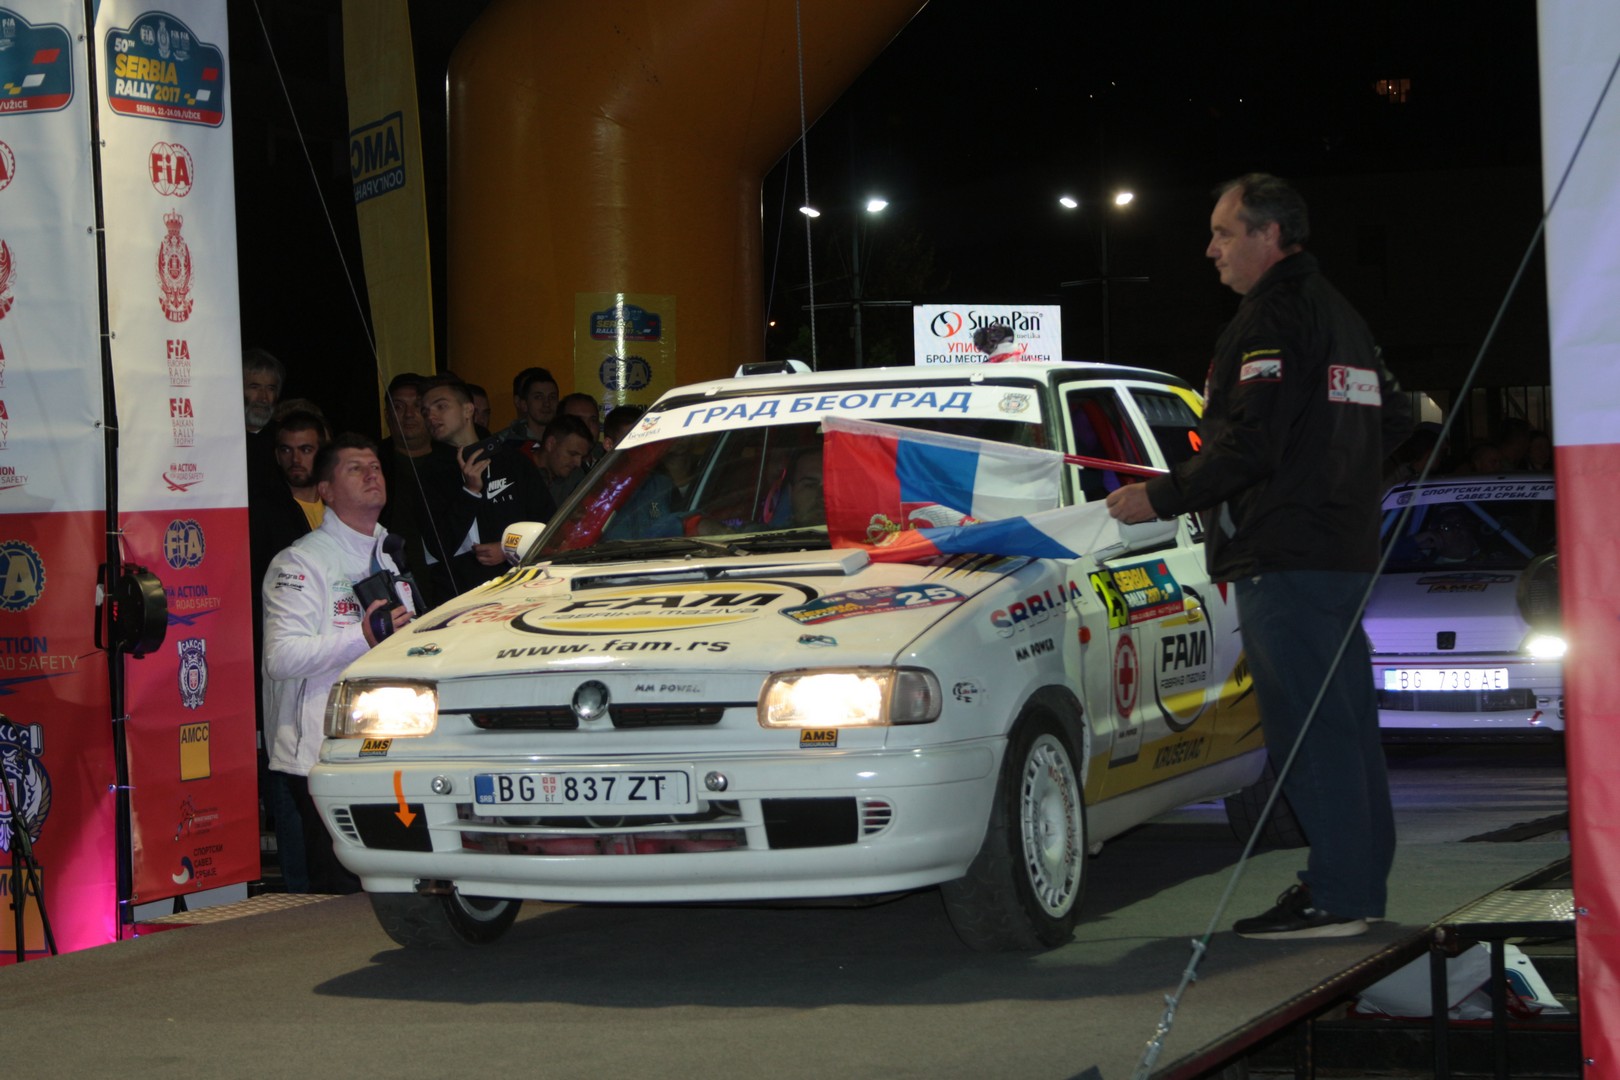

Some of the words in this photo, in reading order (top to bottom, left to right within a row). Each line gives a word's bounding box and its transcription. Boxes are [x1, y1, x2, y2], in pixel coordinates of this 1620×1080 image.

[114, 54, 178, 85] SERBIA
[115, 78, 154, 98] RALLY
[153, 84, 181, 103] 2017
[926, 354, 952, 364] БРОЈ
[955, 354, 988, 363] МЕСТА
[168, 367, 191, 377] RALLY
[682, 400, 780, 428] ГРАД
[790, 391, 972, 414] БЕОГРАД
[173, 428, 195, 438] RALLY
[178, 463, 197, 472] ACTION
[1, 476, 28, 484] SAFETY
[488, 477, 508, 491] NIKE
[1421, 486, 1481, 496] СПОРТСКИ
[1455, 493, 1491, 501] САВЕЗ
[505, 535, 520, 547] AMS
[1113, 567, 1154, 593] SERBIA
[177, 585, 208, 597] ACTION
[895, 588, 957, 606] 25
[176, 599, 196, 609] ROAD
[196, 597, 222, 609] SAFETY
[553, 592, 786, 614] FAM
[0, 636, 48, 654] TION
[496, 639, 731, 659] www.fam.rs
[1161, 630, 1207, 672] FAM
[19, 655, 79, 671] SAFETY
[1401, 671, 1422, 689] BG
[1438, 671, 1471, 689] 738
[1480, 670, 1502, 689] AE
[803, 731, 835, 741] AMS
[363, 740, 390, 750] AMS
[498, 775, 536, 802] BG
[564, 776, 616, 802] 837
[628, 775, 666, 801] ZT
